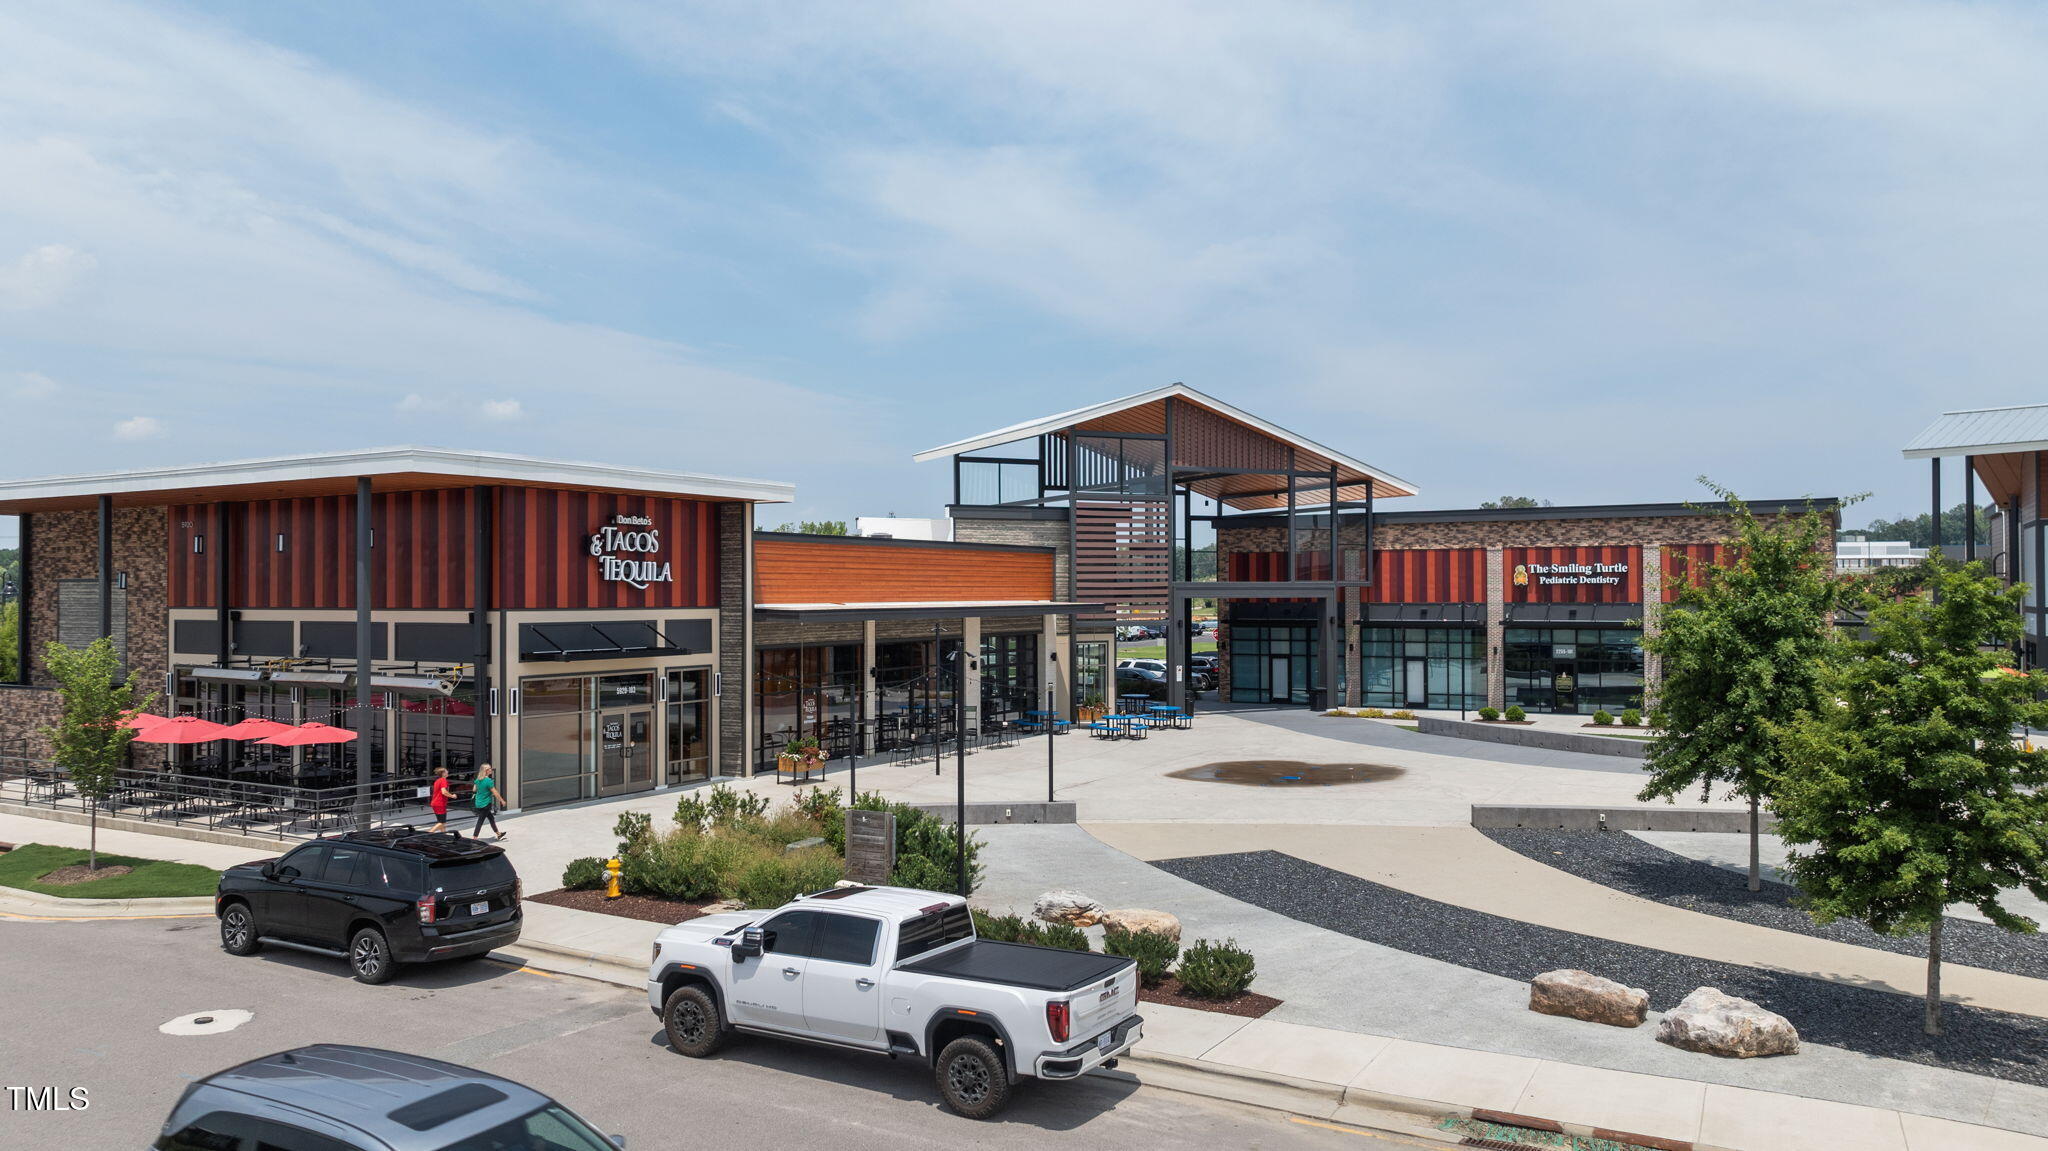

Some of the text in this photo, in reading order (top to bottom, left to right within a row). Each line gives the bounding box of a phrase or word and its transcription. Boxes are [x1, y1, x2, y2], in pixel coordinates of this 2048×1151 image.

[616, 514, 652, 526] Don Beto's
[600, 526, 659, 553] TACOS
[590, 534, 674, 590] & TEQUILA
[1528, 562, 1628, 575] The Smiling Turtle
[1539, 576, 1620, 586] Pediatric Dentistry
[1099, 986, 1120, 1002] GMC
